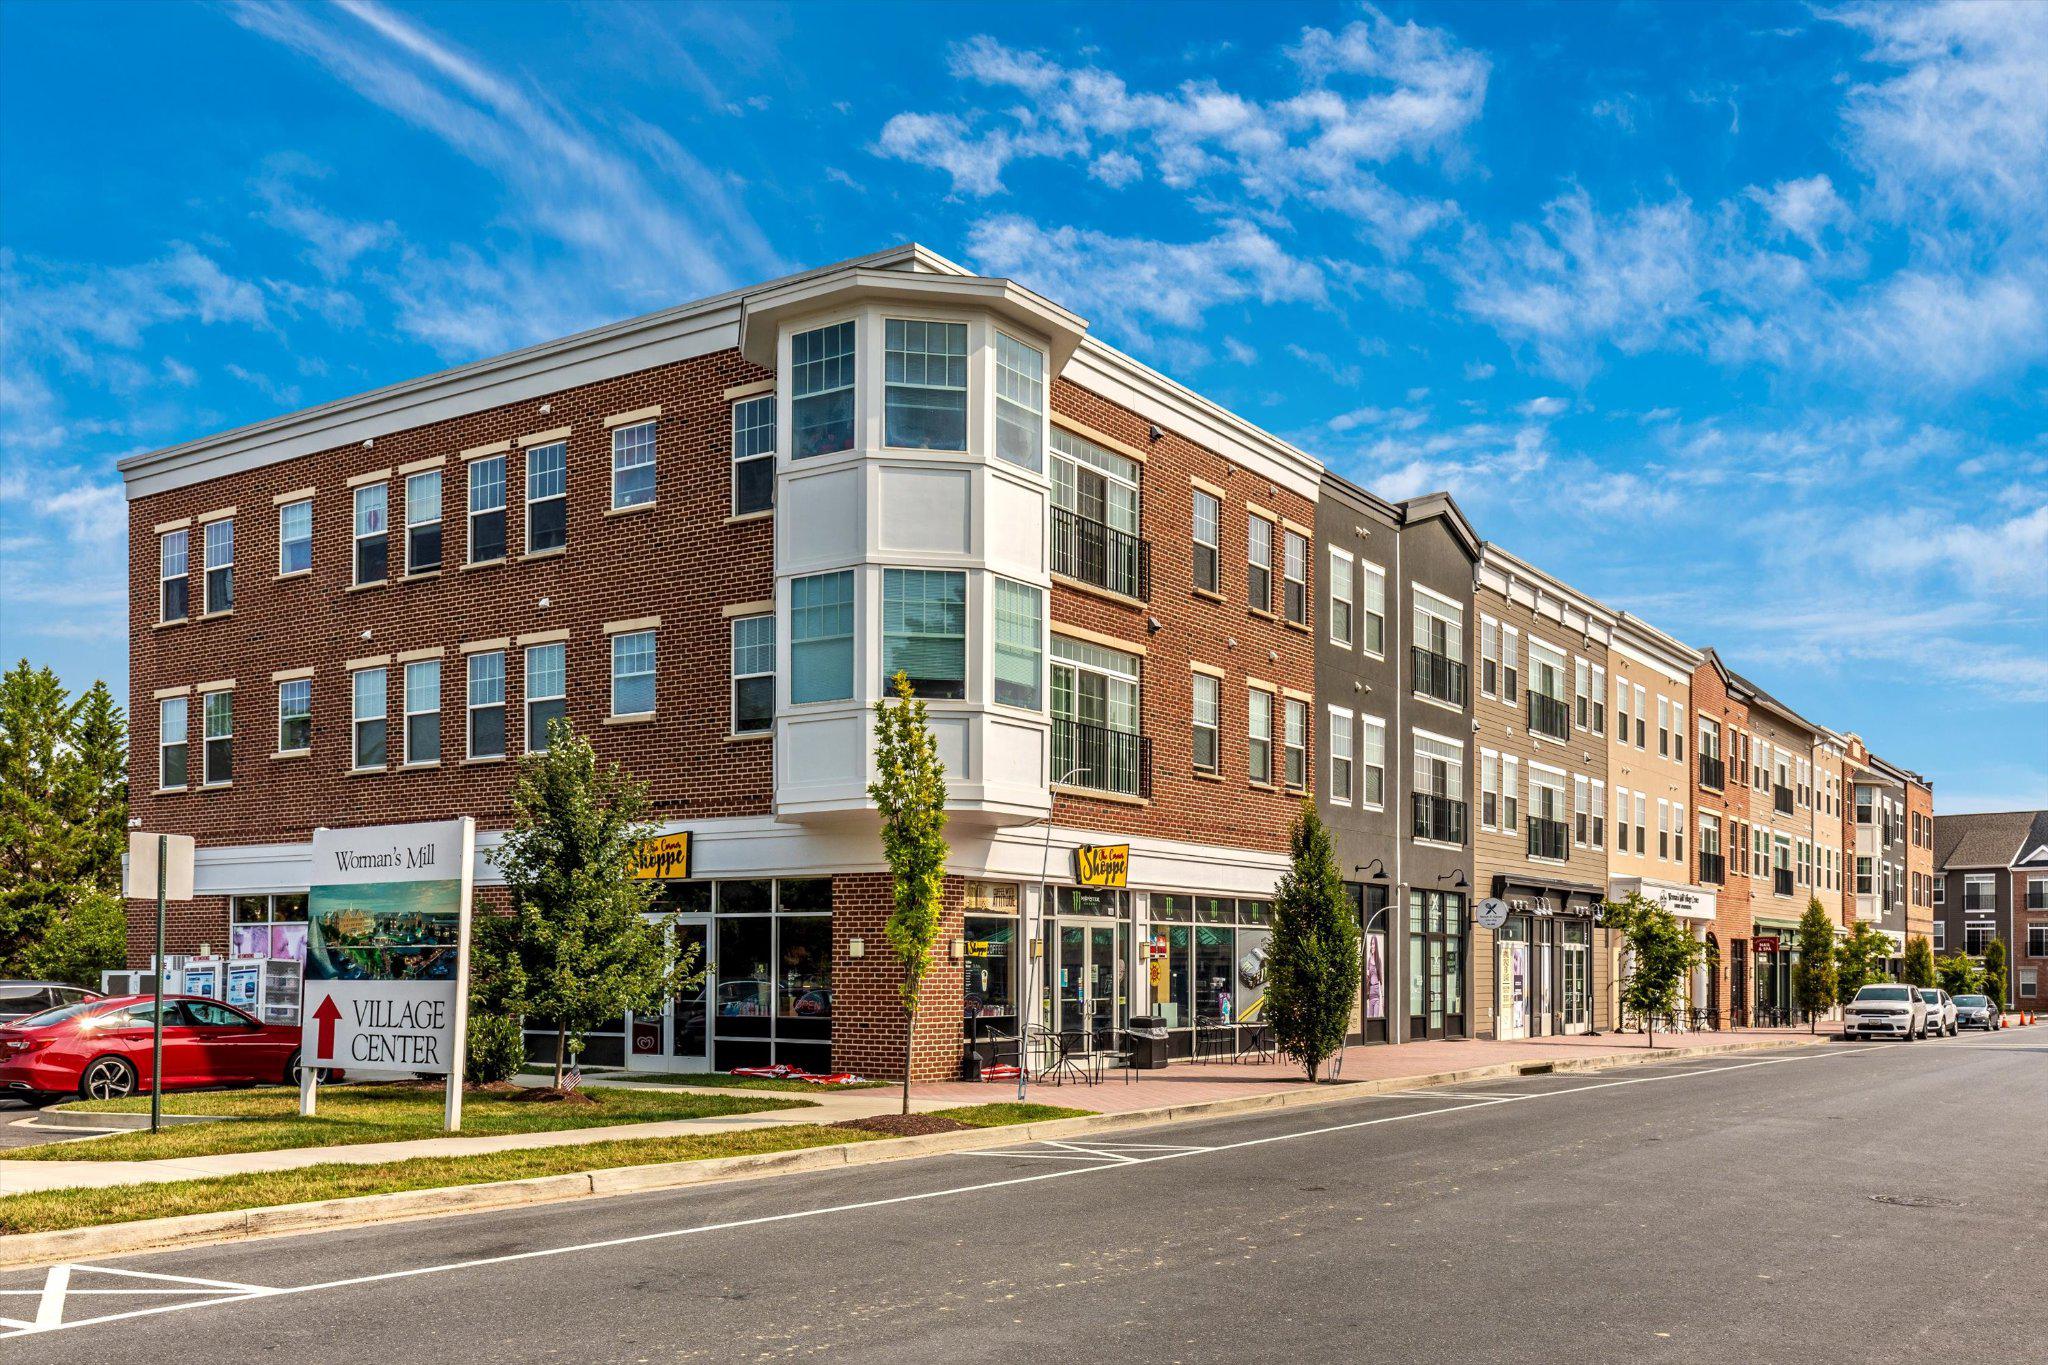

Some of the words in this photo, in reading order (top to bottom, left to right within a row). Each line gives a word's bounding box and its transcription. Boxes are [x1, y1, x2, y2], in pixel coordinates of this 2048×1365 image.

[334, 846, 401, 872] Worman's
[406, 843, 435, 869] Mill
[1081, 844, 1126, 884] Shoppe
[353, 1000, 445, 1029] VILLAGE
[351, 1034, 440, 1064] CENTER
